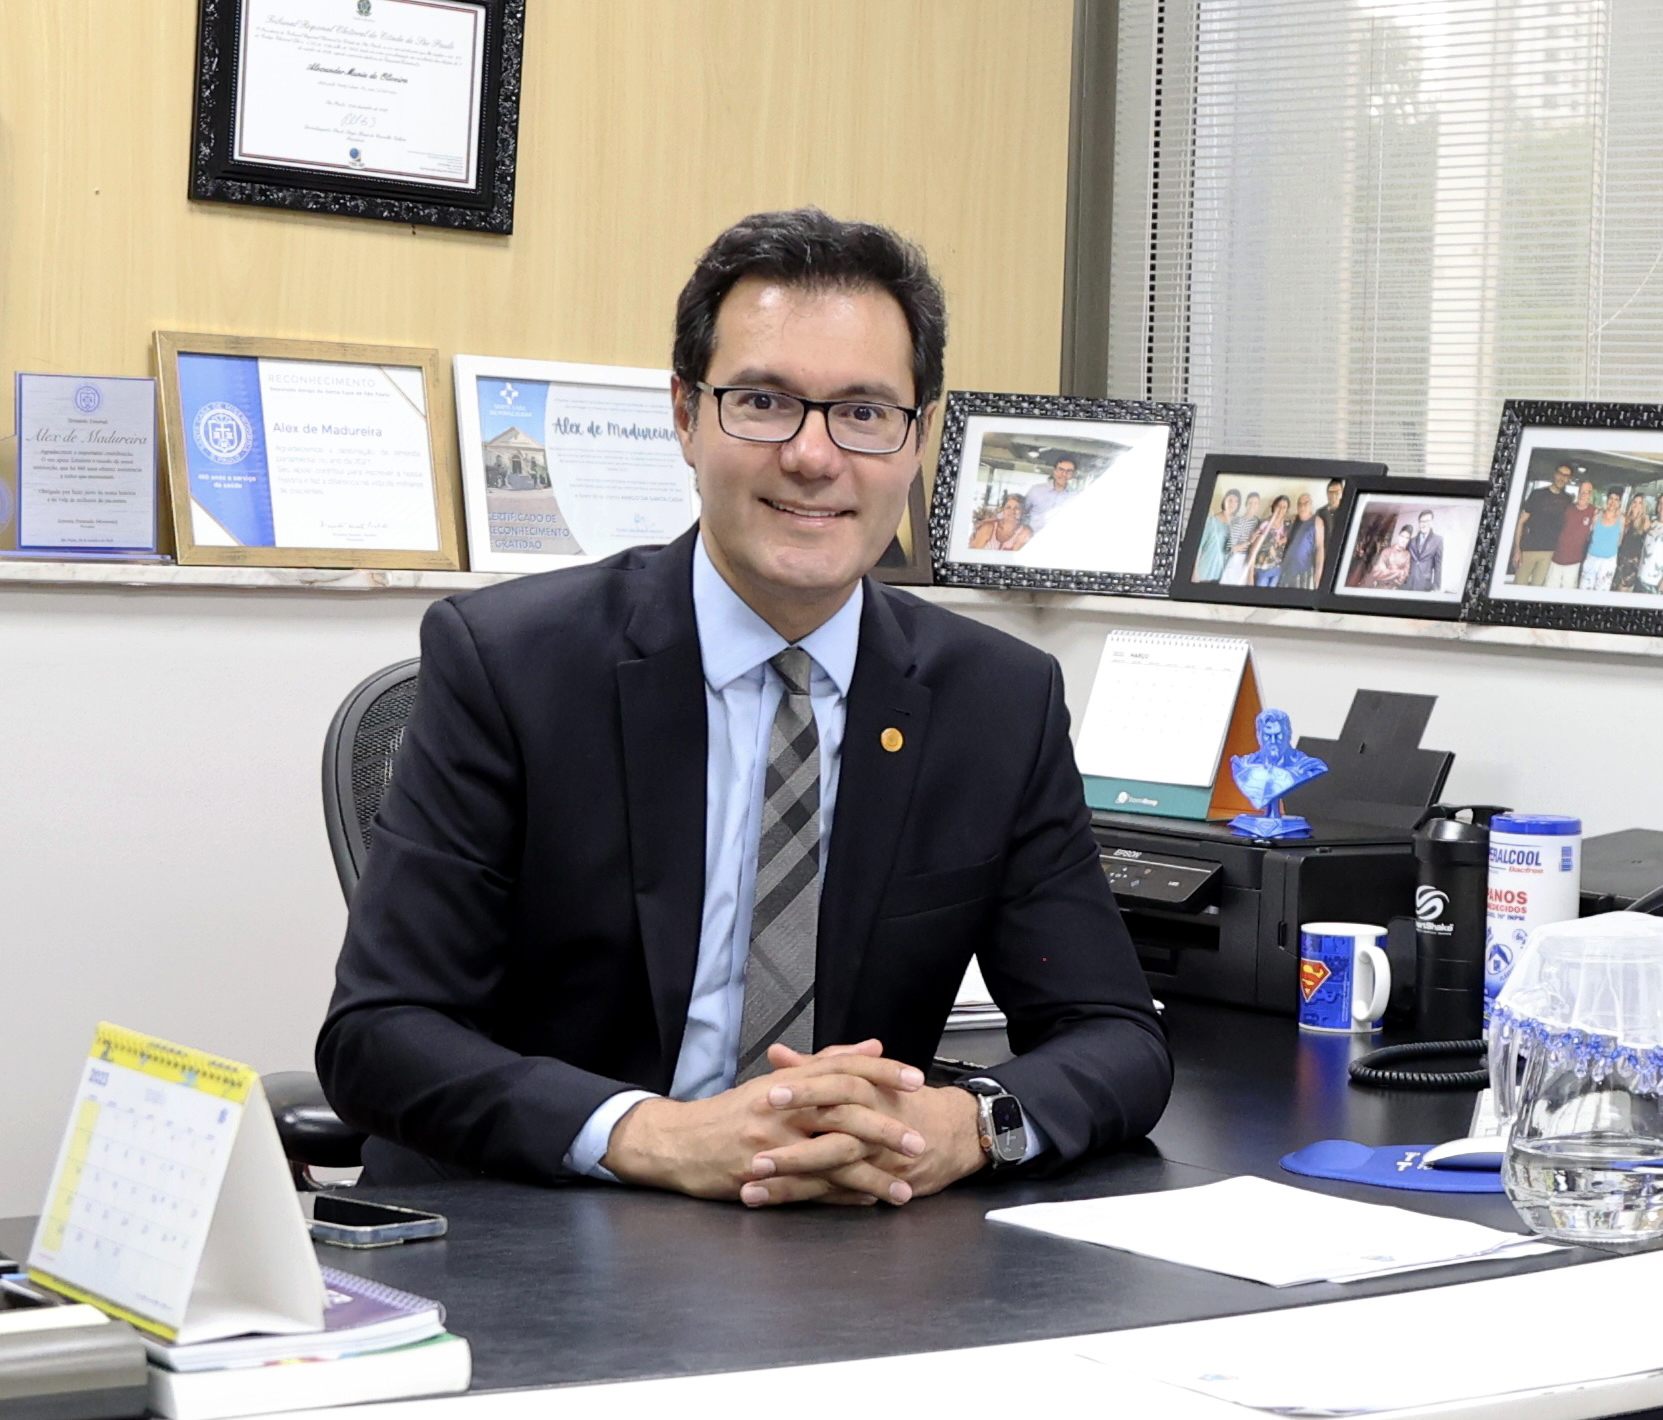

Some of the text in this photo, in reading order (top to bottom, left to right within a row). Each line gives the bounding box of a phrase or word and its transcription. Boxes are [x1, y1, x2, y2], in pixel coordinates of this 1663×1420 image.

[265, 15, 300, 29] Tribunal
[300, 19, 335, 34] Regional
[334, 24, 368, 38] Eleitoral
[432, 38, 455, 49] Paulo
[369, 71, 378, 80] de
[380, 72, 408, 84] Oliveira
[268, 374, 375, 388] RECONHECIMENTO
[273, 421, 382, 438] Alex de Madureira
[552, 417, 584, 436] Alex
[587, 420, 603, 434] de
[26, 428, 148, 445] Alex de Madureira
[545, 514, 557, 523] DE
[1113, 848, 1143, 859] EPSON
